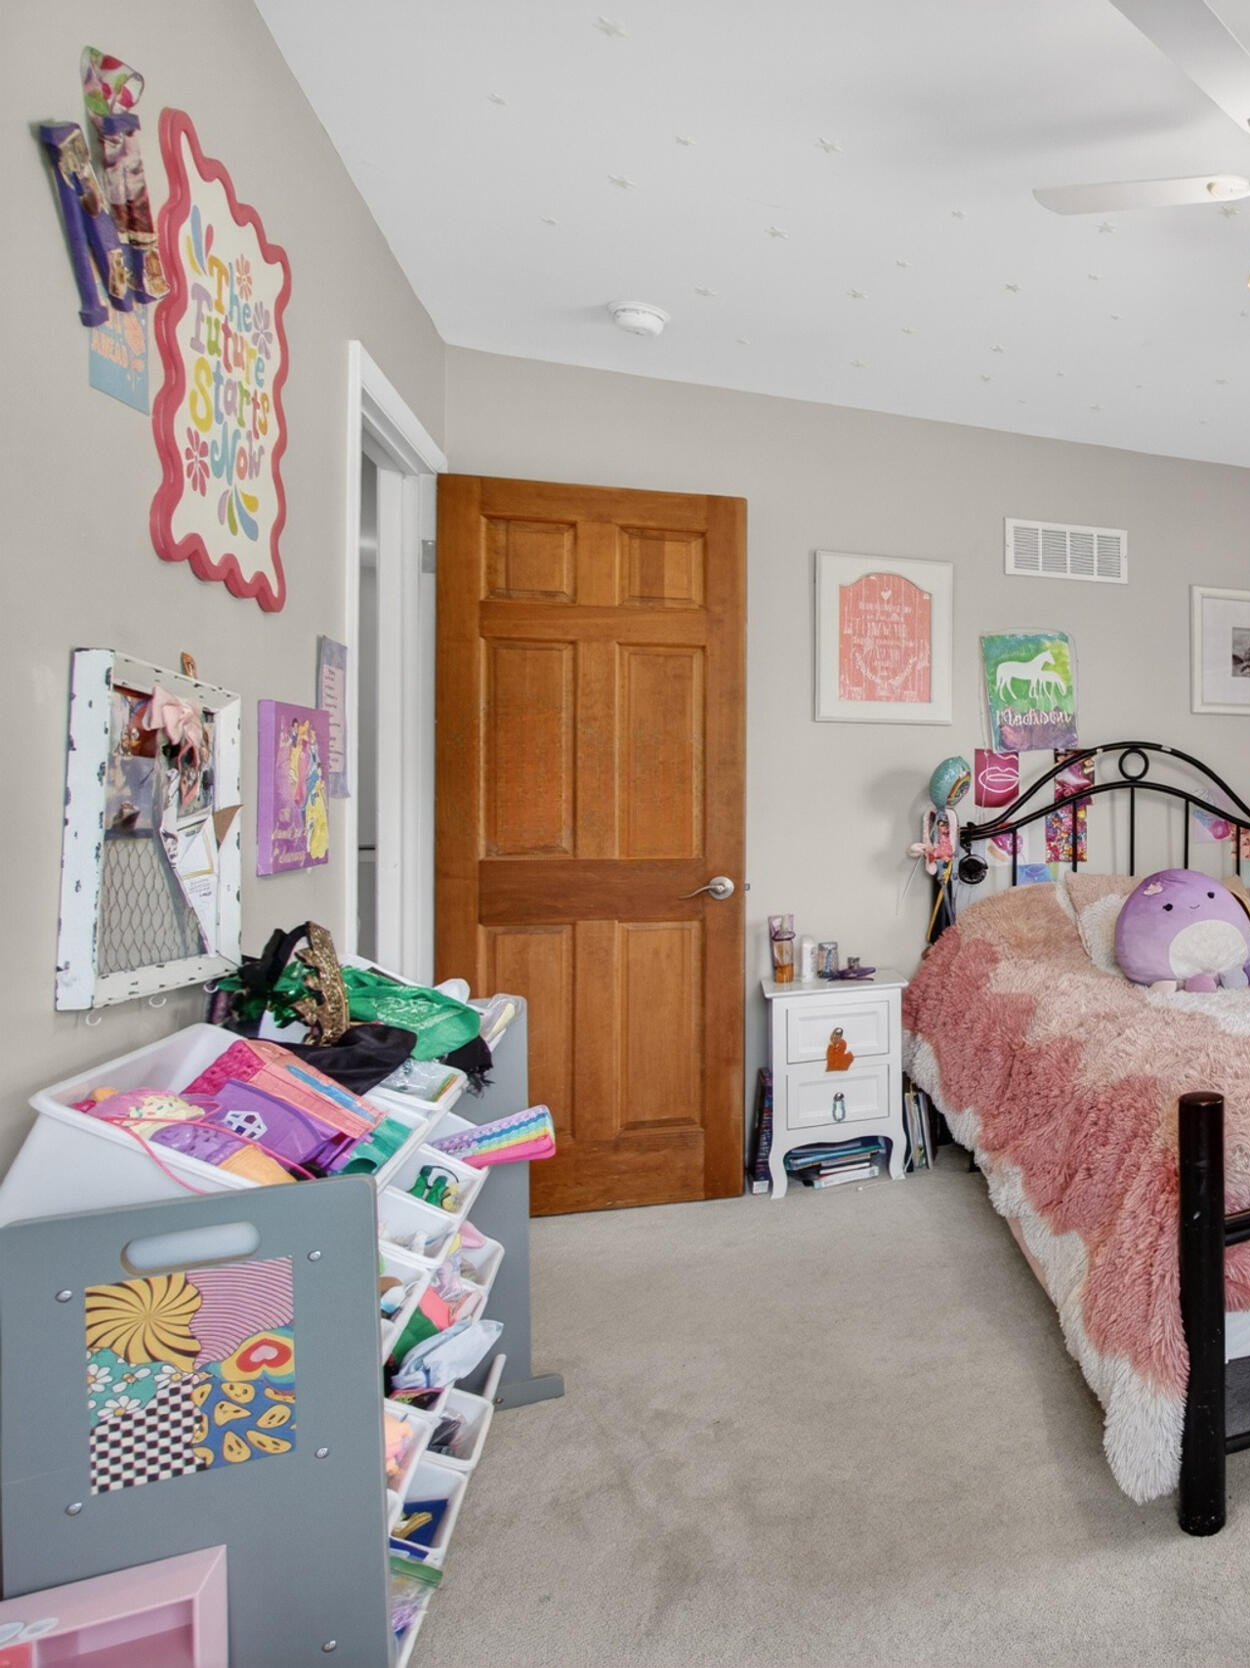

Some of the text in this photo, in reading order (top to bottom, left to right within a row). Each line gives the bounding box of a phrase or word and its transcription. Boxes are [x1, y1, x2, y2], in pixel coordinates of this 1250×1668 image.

[207, 254, 252, 333] The
[190, 282, 266, 388] Future
[189, 356, 270, 440] Starts
[210, 421, 266, 487] Now
